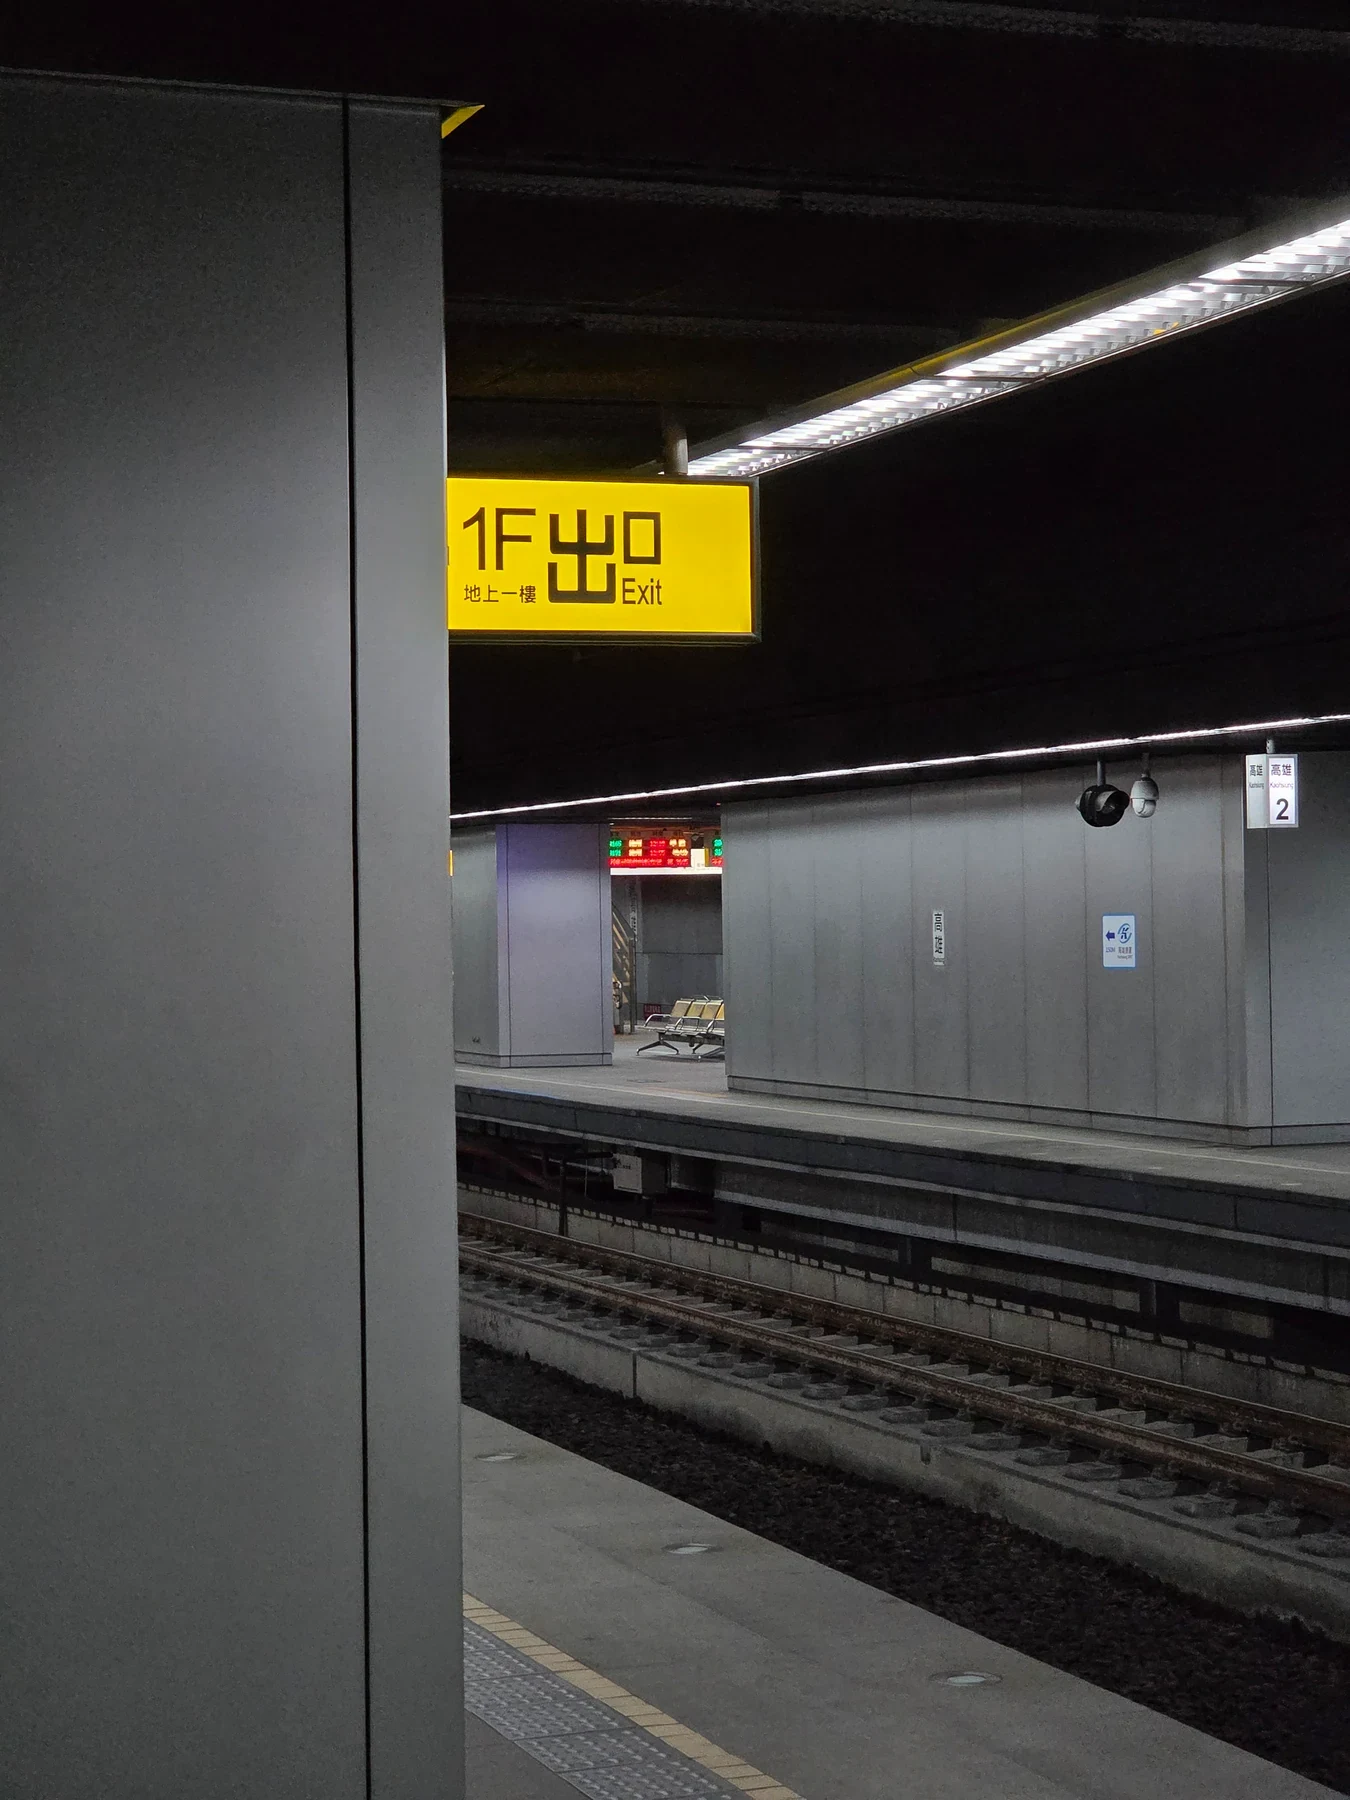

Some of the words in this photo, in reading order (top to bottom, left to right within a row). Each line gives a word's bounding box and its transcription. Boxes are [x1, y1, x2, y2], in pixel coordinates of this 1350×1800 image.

[462, 507, 536, 571] 1F
[547, 509, 662, 604] 出口
[463, 584, 537, 604] 地上一樓
[622, 578, 662, 605] Exit
[1271, 763, 1292, 776] 高雄
[1276, 798, 1289, 820] 2
